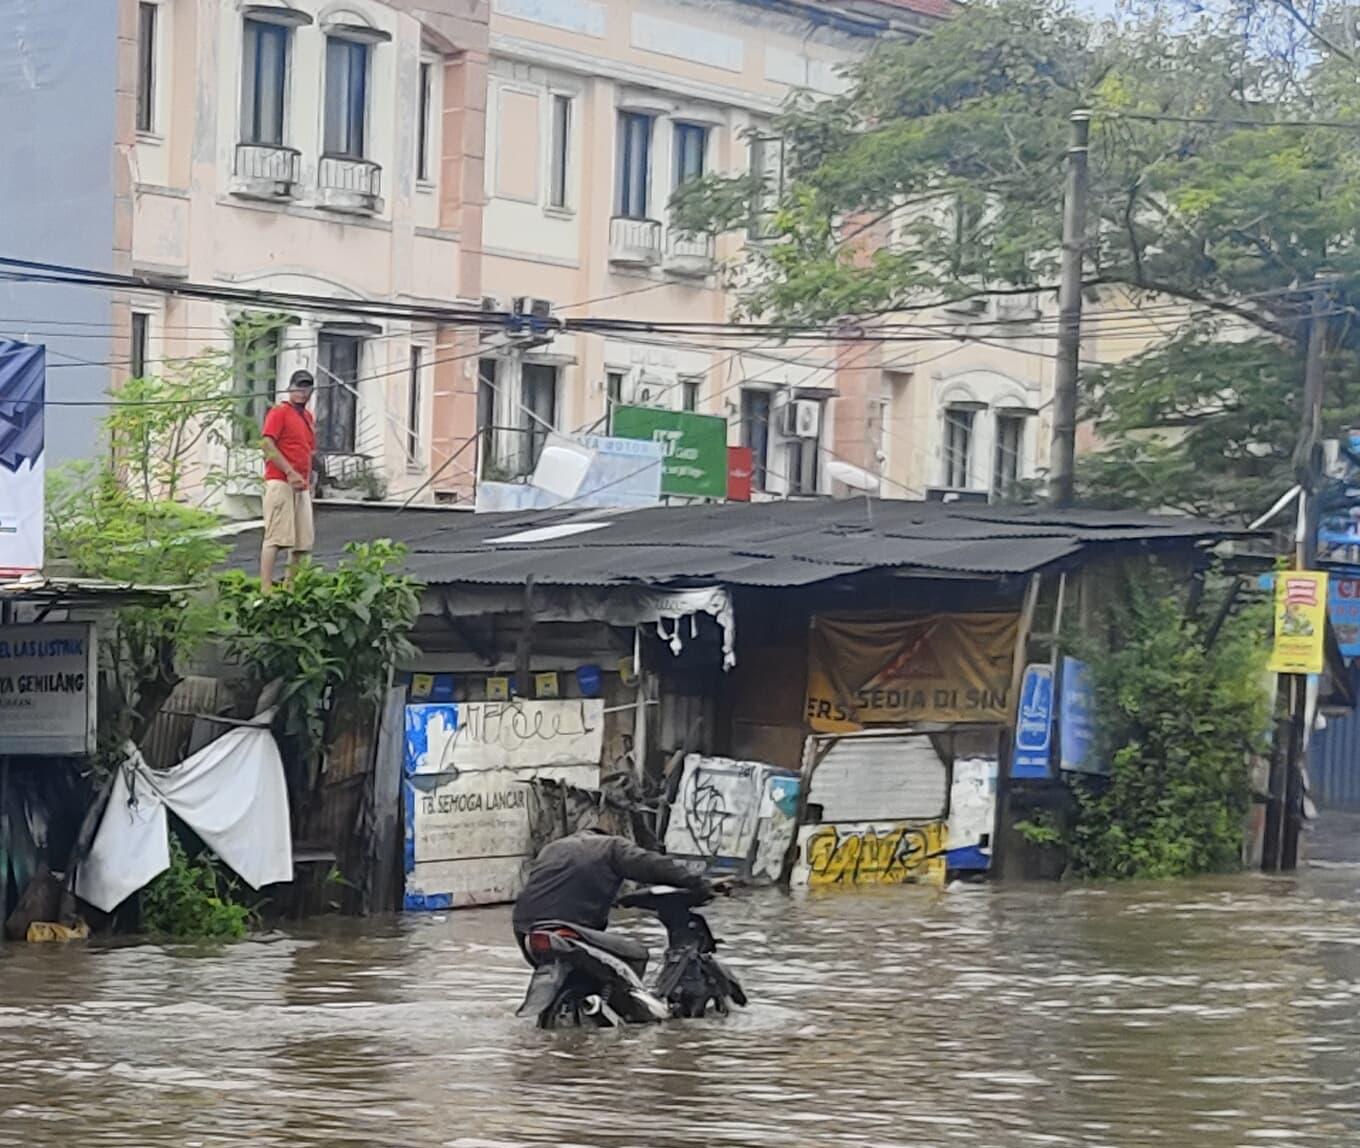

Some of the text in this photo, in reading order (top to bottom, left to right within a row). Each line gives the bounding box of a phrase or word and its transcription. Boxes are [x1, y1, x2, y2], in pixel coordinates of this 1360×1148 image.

[18, 672, 85, 694] GEMILANG
[856, 690, 926, 711] SEDIA
[935, 689, 959, 709] DI
[438, 794, 482, 813] SEMOGA
[486, 791, 526, 811] LANCAR
